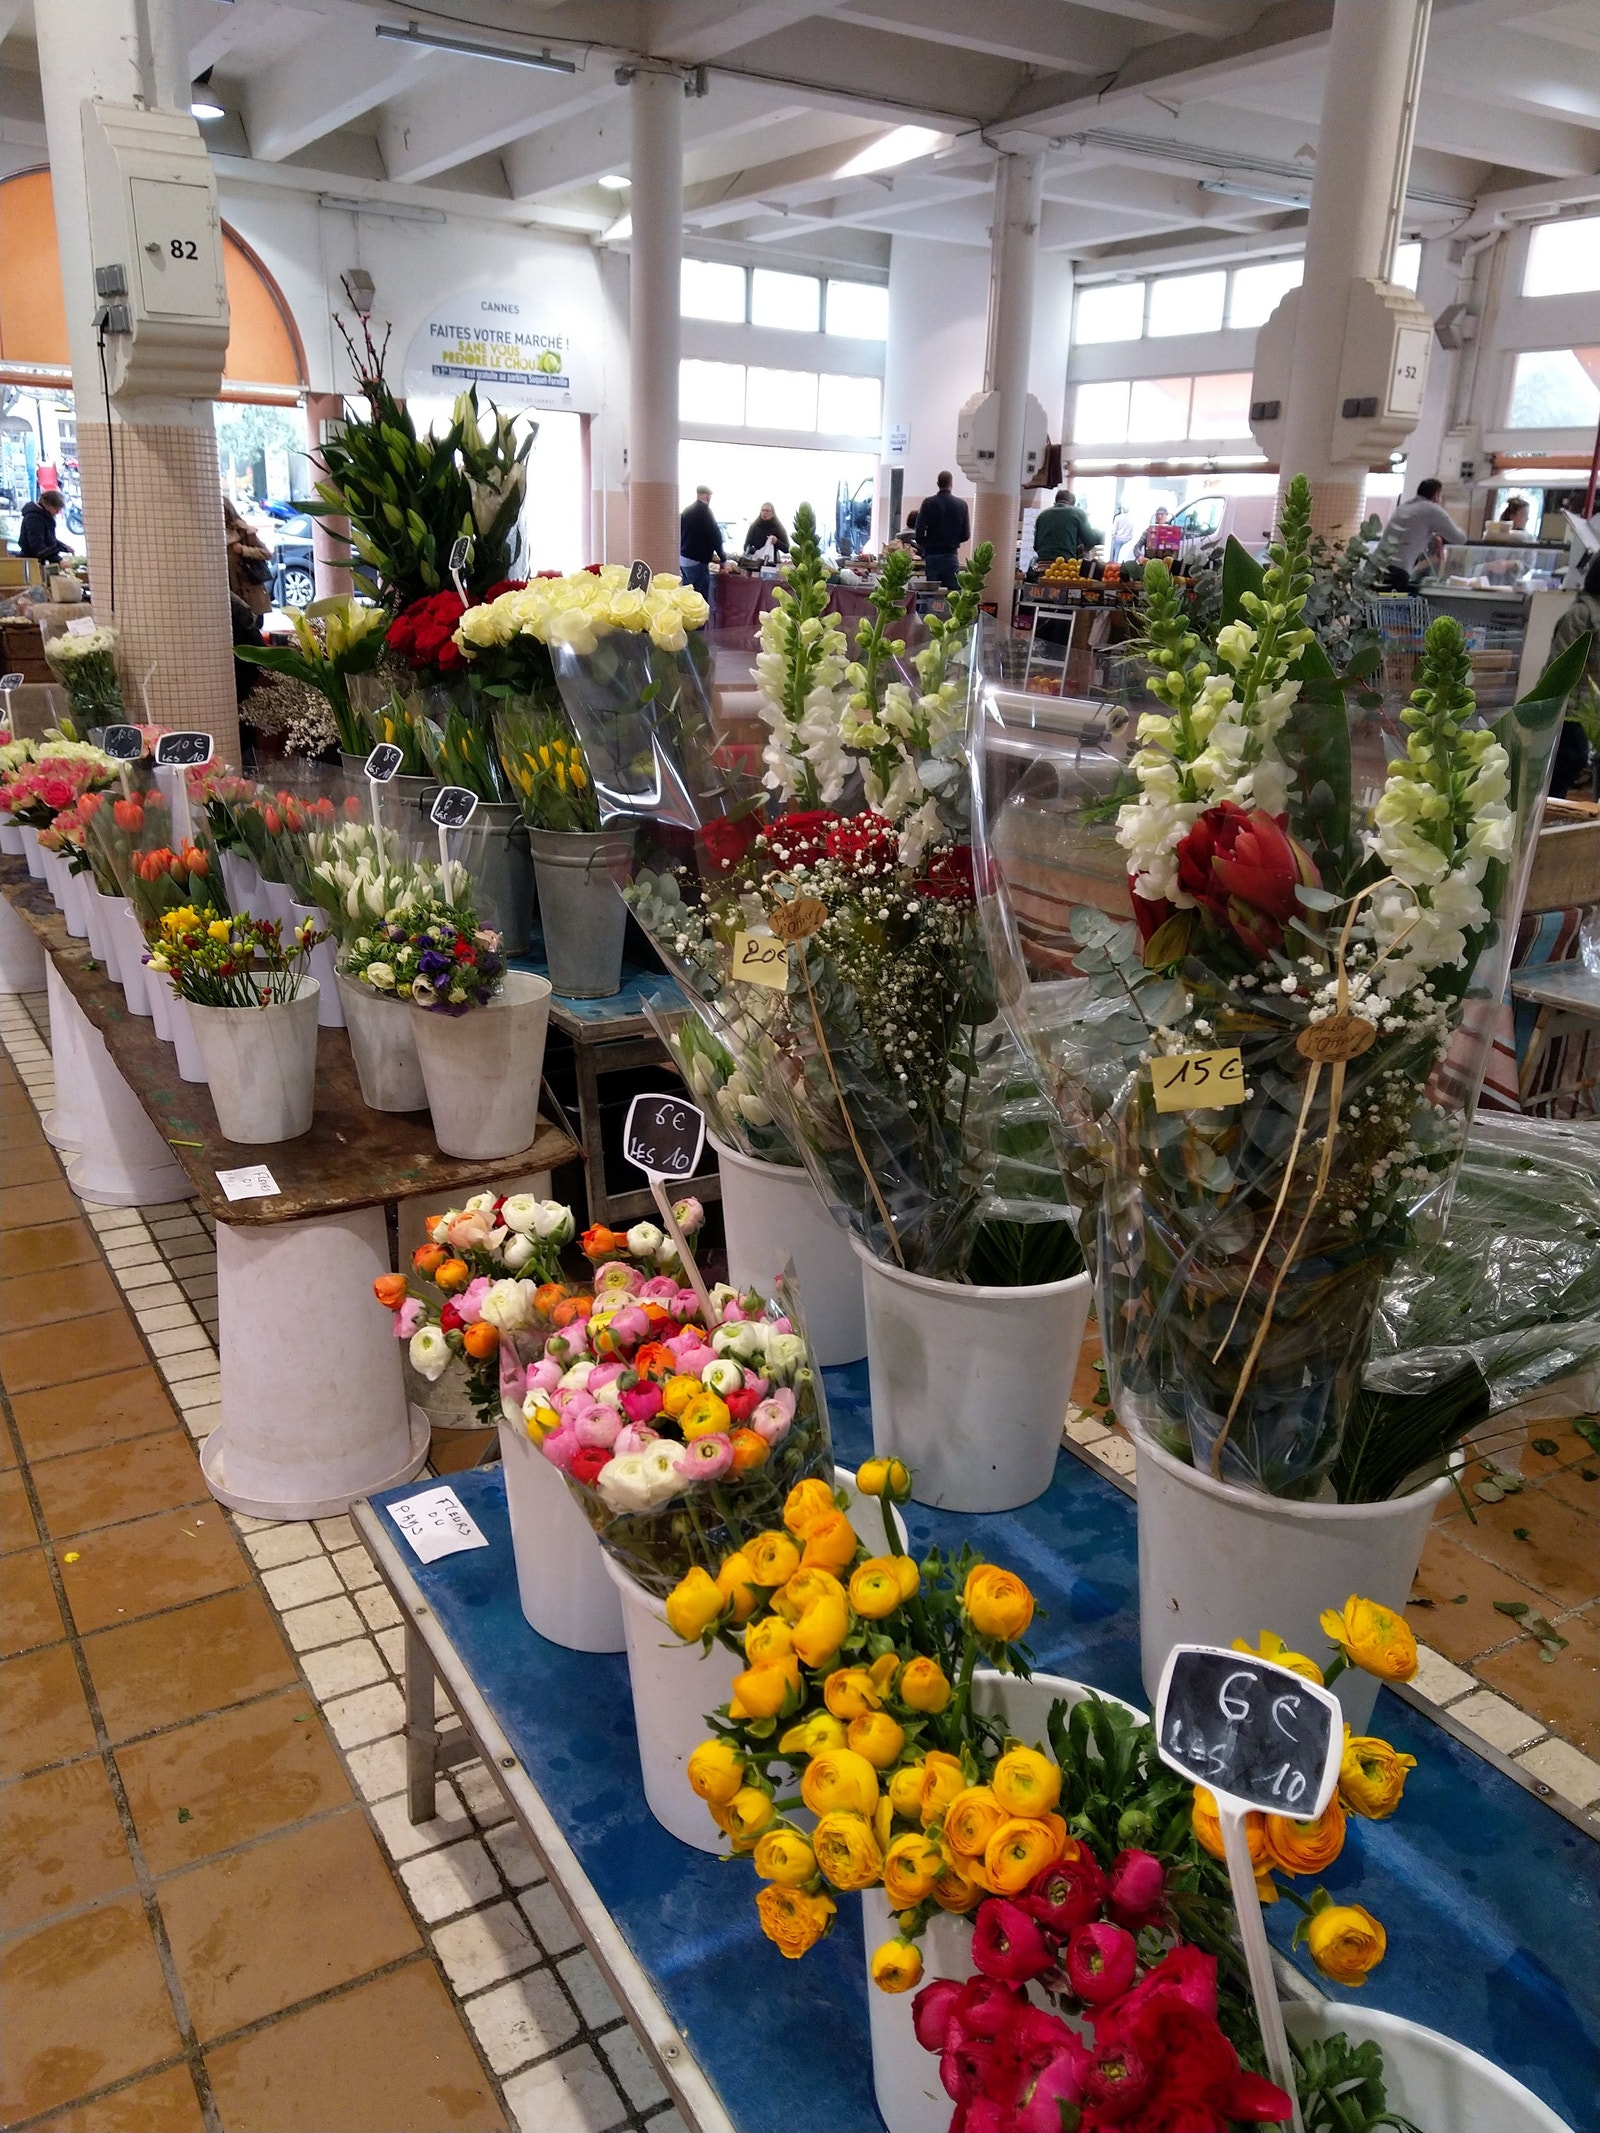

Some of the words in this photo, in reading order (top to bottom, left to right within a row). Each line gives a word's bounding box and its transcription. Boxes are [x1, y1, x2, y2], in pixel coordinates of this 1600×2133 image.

[170, 240, 198, 260] 82
[481, 301, 520, 314] CANNES
[430, 324, 471, 340] FAITES
[474, 328, 511, 344] VOTRE
[515, 333, 562, 350] MARCHÉ
[458, 340, 486, 354] SANS
[490, 343, 520, 356] VOUS
[442, 351, 487, 367] PRENDRE
[490, 356, 502, 368] LE
[504, 357, 536, 371] CHOU
[1404, 365, 1416, 380] 52
[630, 1136, 656, 1164] LES
[662, 1146, 690, 1170] 10
[428, 1512, 445, 1526] DU
[1251, 1762, 1306, 1802] 10
